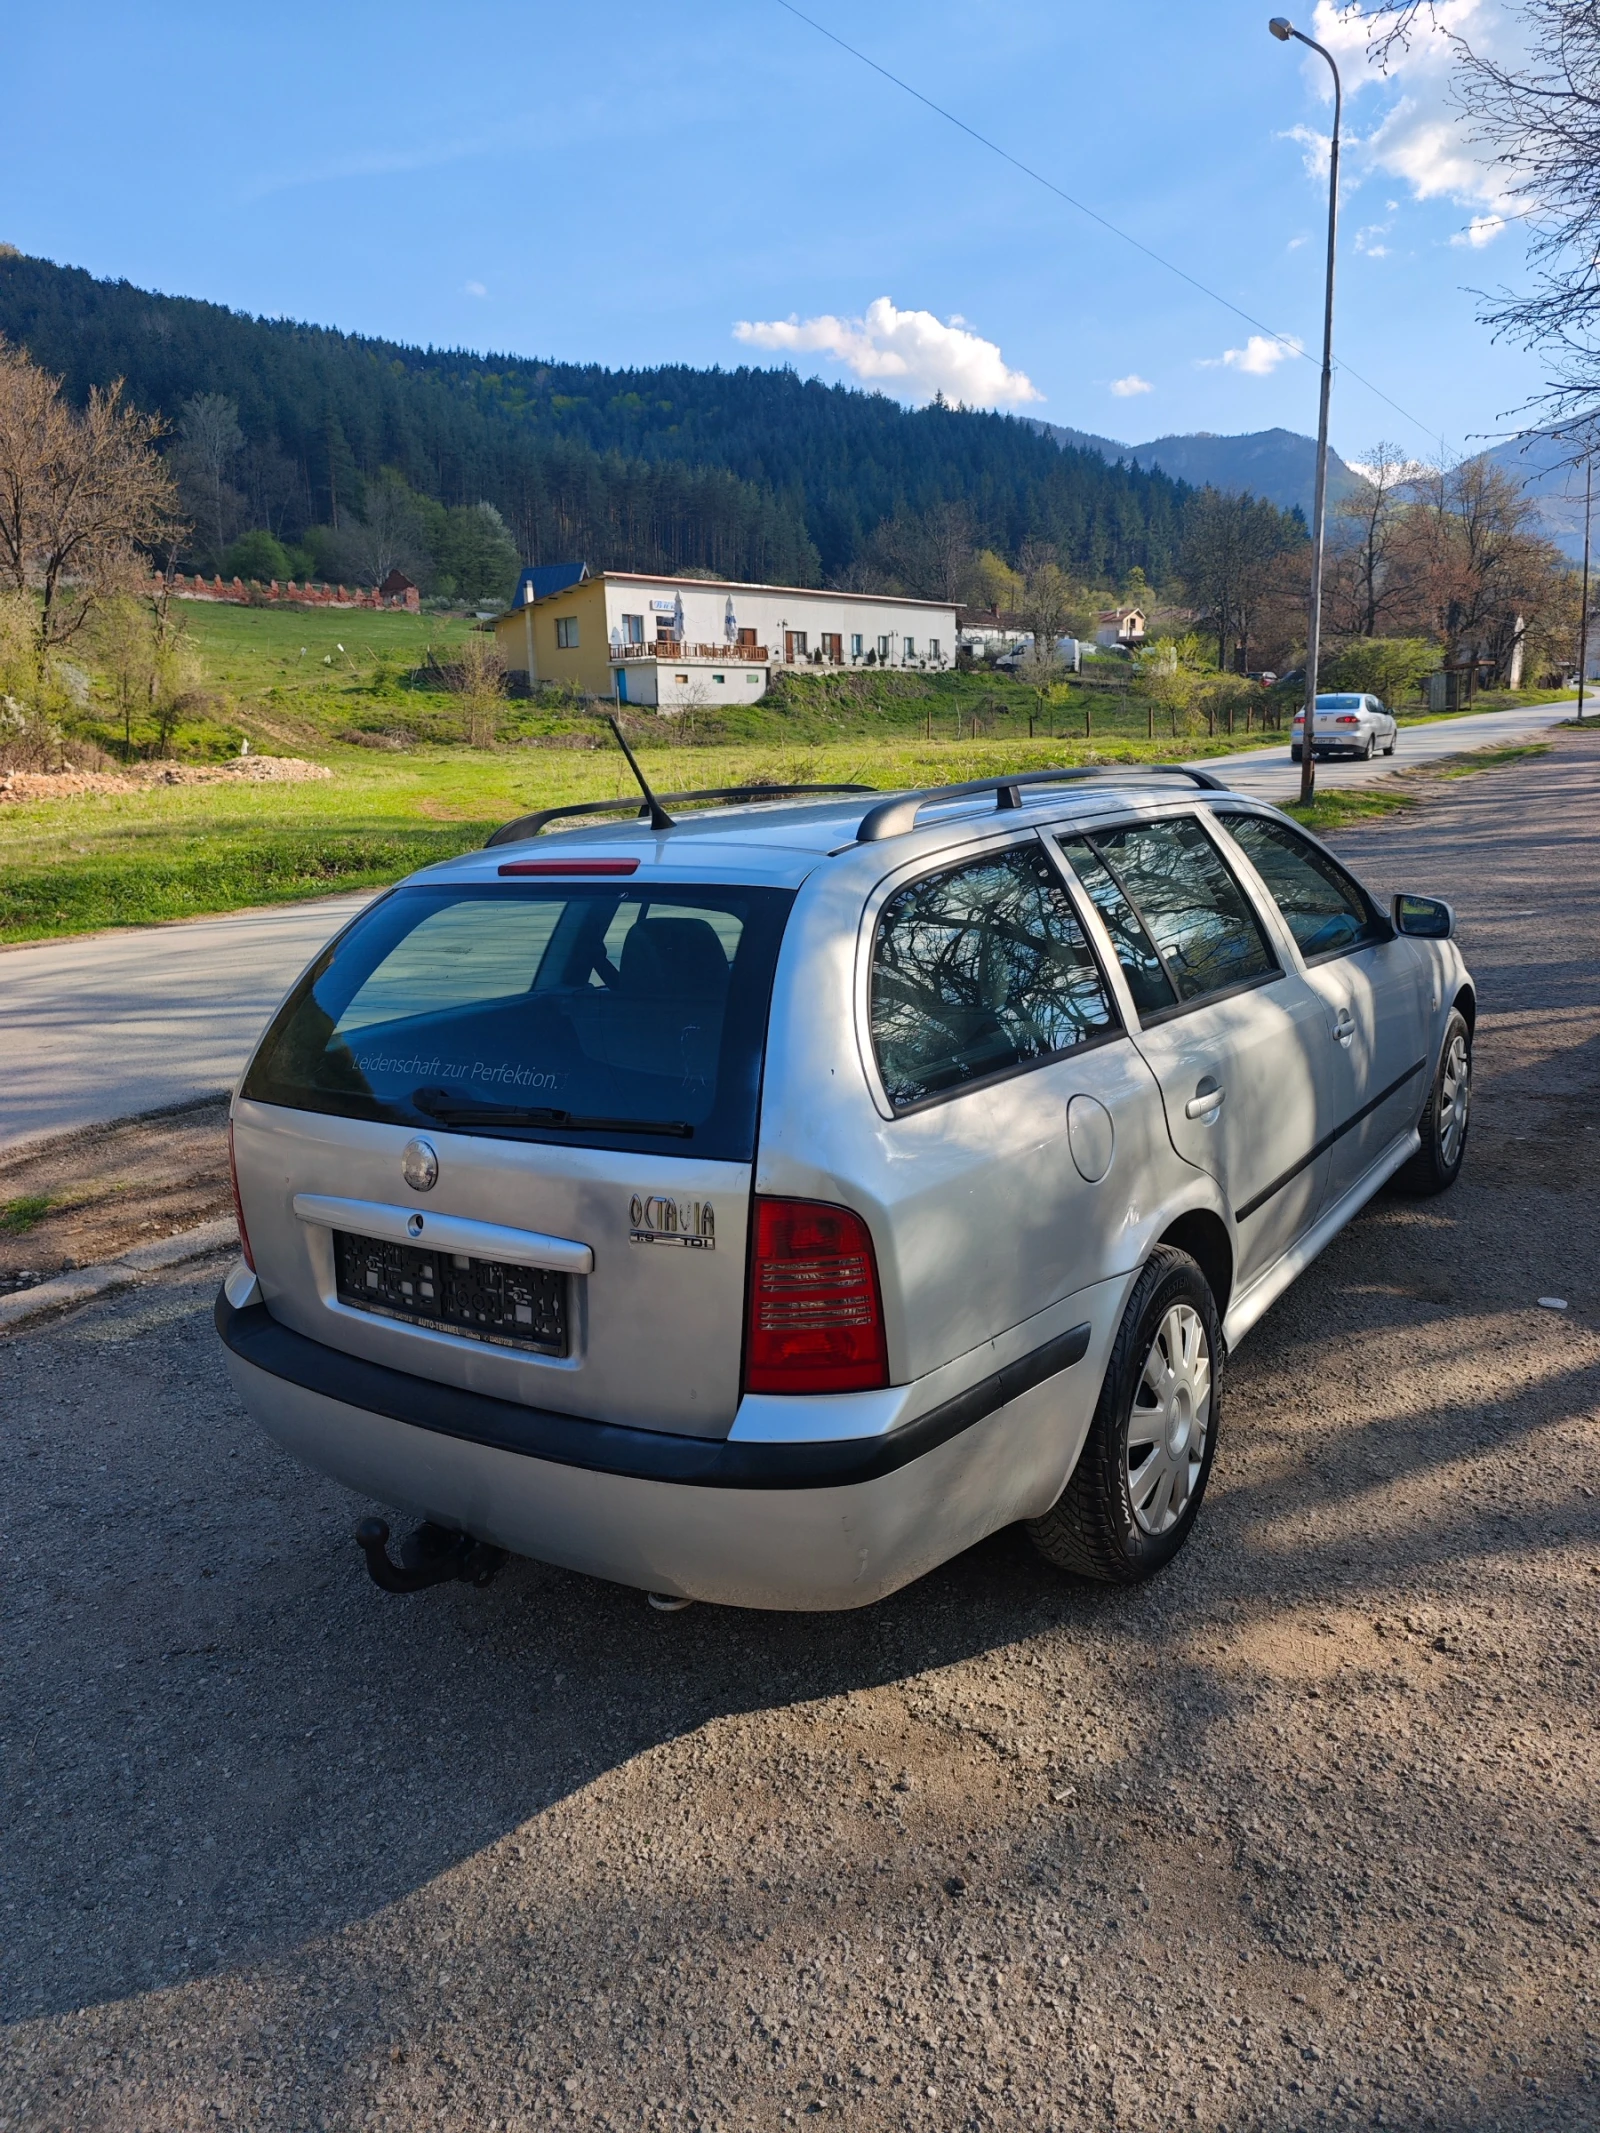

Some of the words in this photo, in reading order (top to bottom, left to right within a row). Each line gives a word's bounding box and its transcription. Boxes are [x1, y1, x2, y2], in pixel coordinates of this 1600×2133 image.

[352, 1053, 440, 1076] Leidenschaft
[442, 1063, 468, 1079] zur
[470, 1062, 558, 1090] Perfektion.
[683, 1237, 708, 1248] TDI
[418, 1317, 461, 1336] AUTO-TEMMEL
